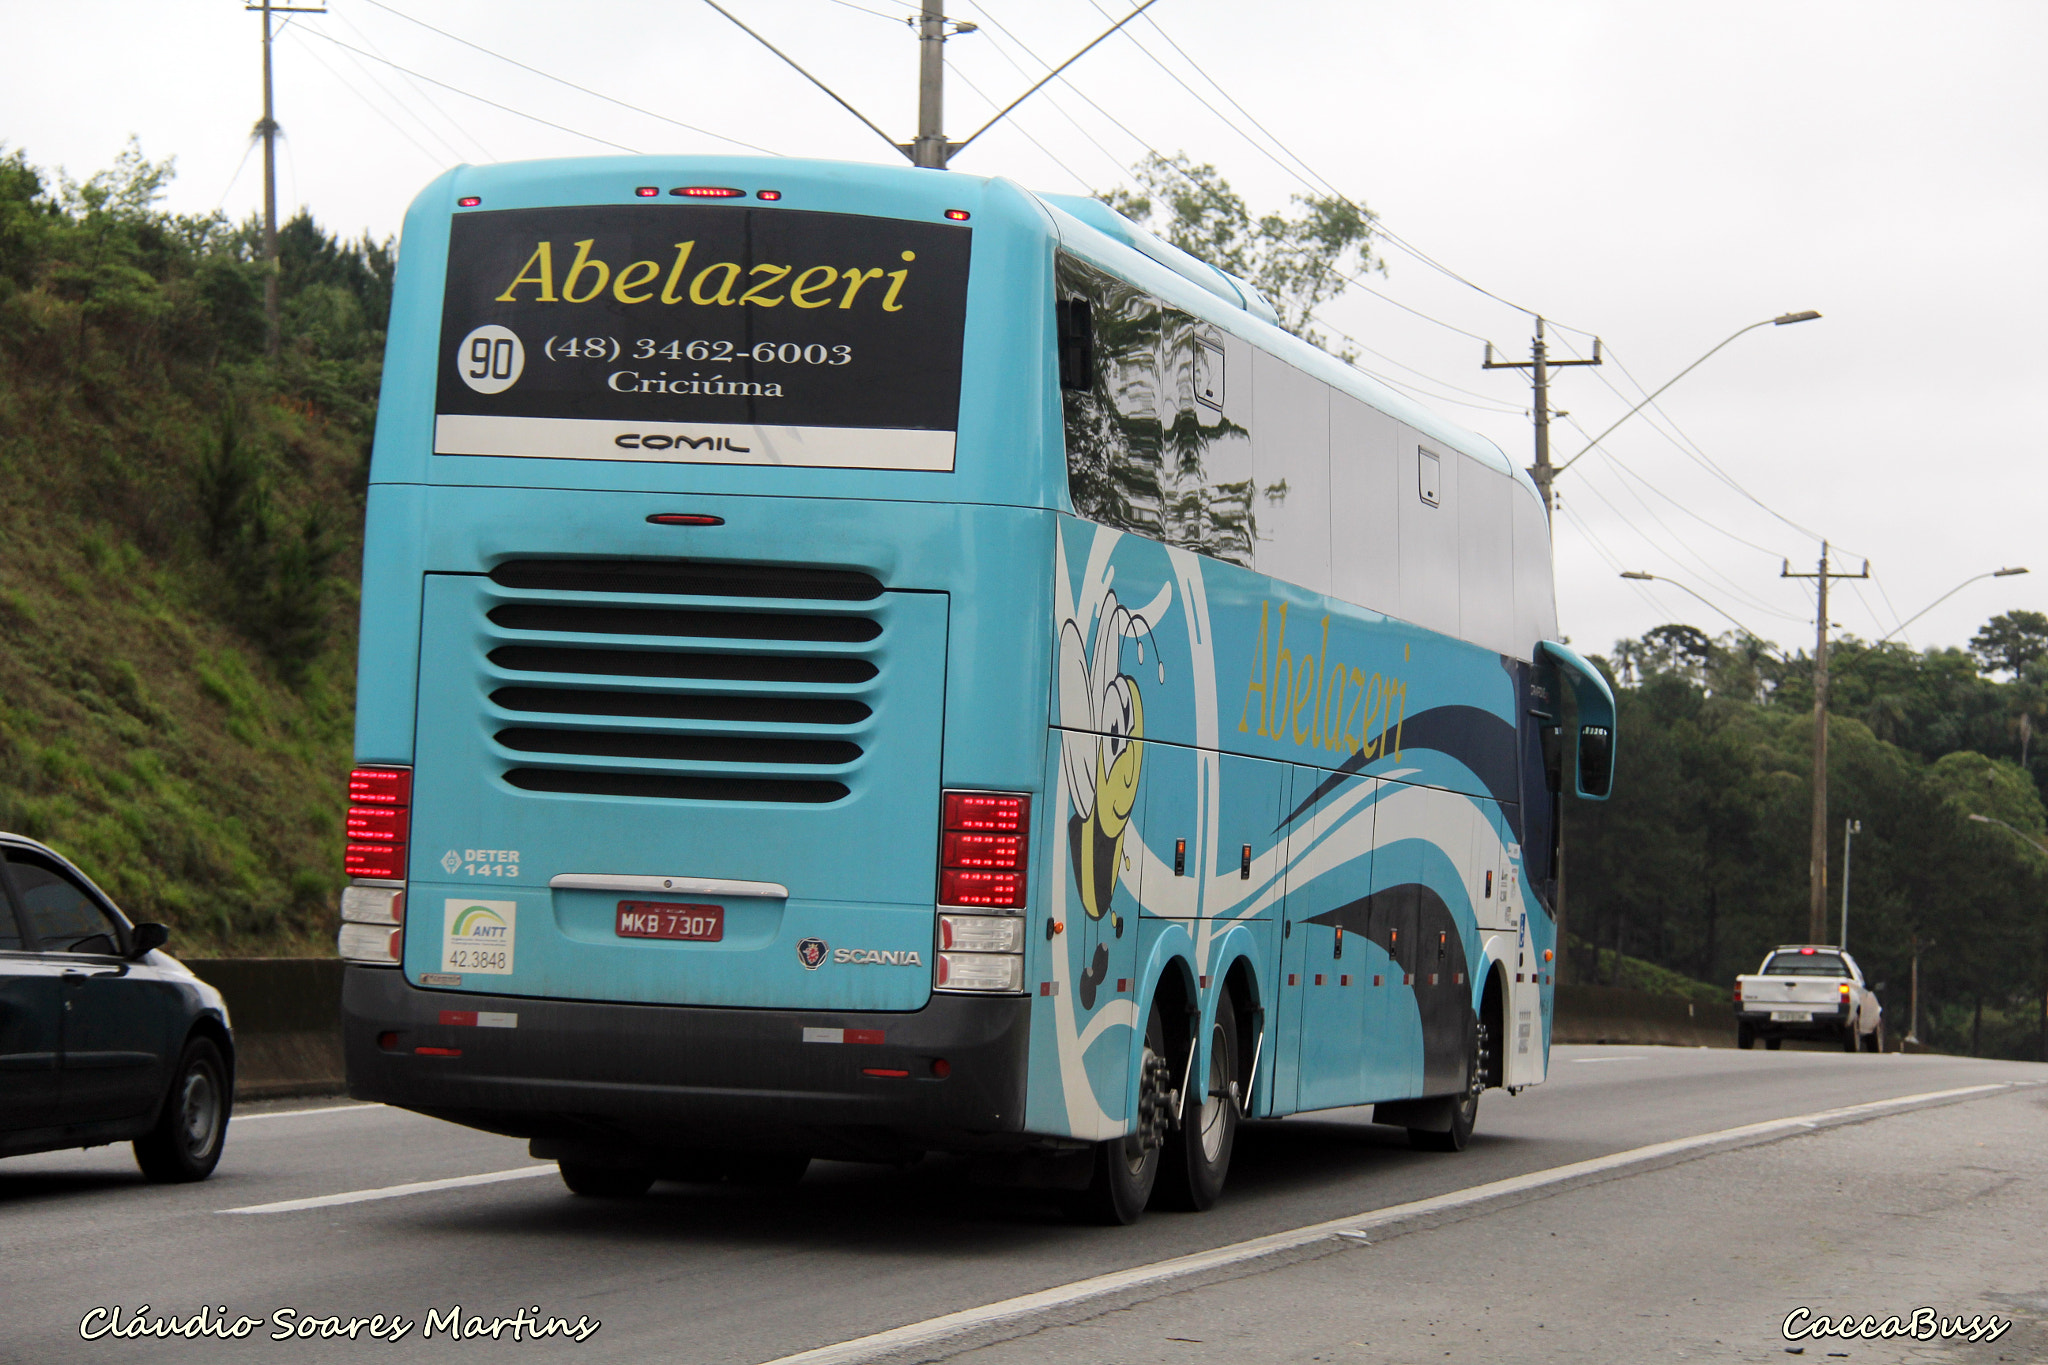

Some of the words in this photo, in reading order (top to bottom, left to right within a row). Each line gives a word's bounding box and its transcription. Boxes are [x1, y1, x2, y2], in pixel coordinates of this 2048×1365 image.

[495, 238, 917, 312] Abelazeri
[470, 338, 513, 380] 90
[543, 335, 621, 363] (48)
[633, 338, 853, 366] 3462-6003
[607, 370, 785, 398] Criciúma
[614, 433, 751, 454] COMIL
[1238, 599, 1412, 764] Abelazeri
[464, 849, 520, 863] DETER
[464, 863, 520, 877] 1413
[472, 926, 507, 938] ANTT
[621, 913, 659, 933] MKB
[667, 915, 717, 936] 7307
[449, 950, 506, 970] 42.3848
[833, 948, 922, 967] SCANIA
